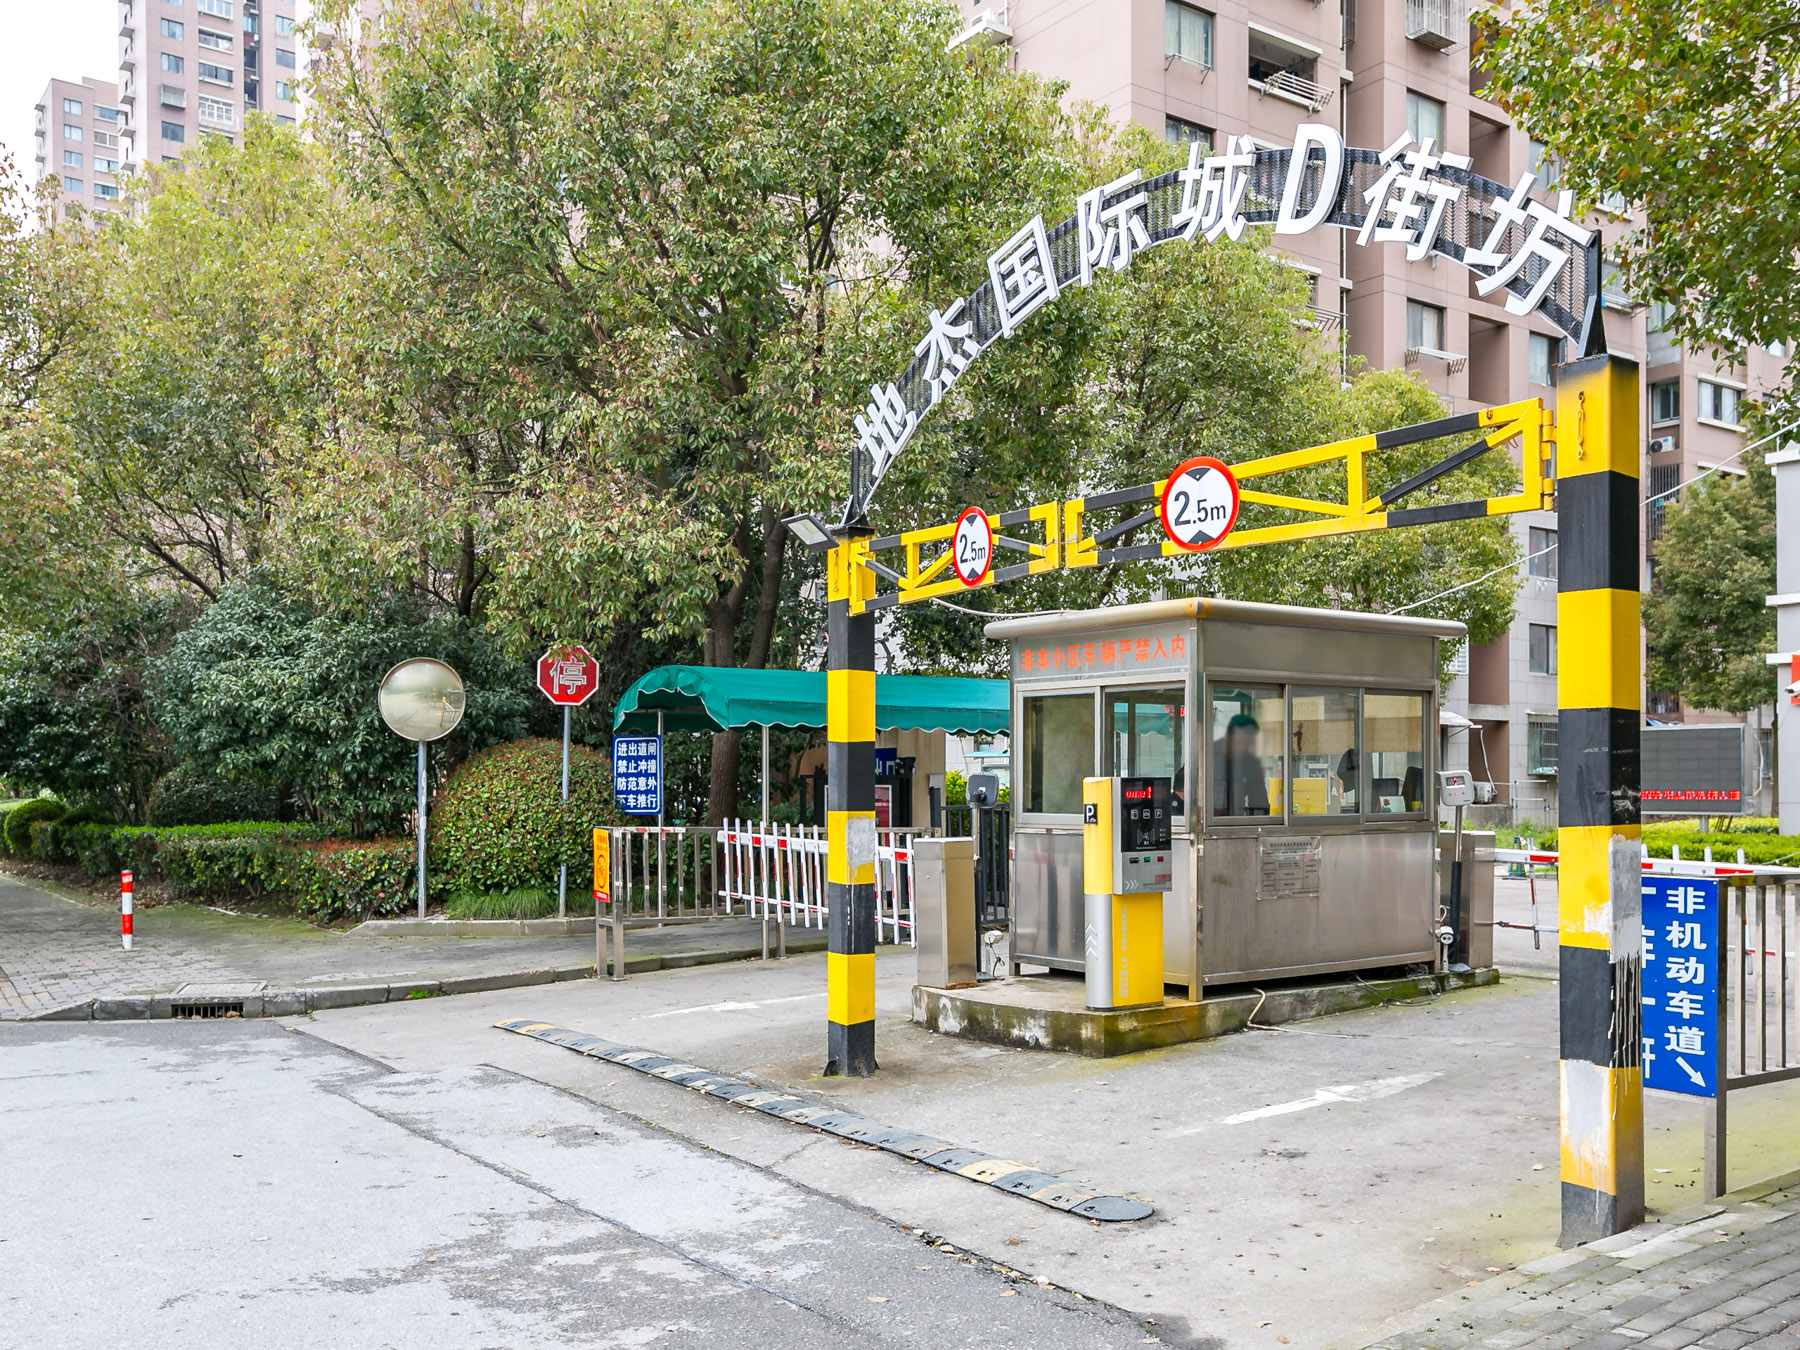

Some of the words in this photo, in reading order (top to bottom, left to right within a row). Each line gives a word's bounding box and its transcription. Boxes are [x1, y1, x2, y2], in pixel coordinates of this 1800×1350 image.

[851, 122, 1596, 477] 地杰国际城D街坊
[1173, 490, 1227, 527] 2.5m
[959, 533, 987, 564] 2.5m
[1020, 633, 1186, 672] 非本小区车辆严禁入内
[550, 655, 587, 694] 停
[617, 759, 657, 773] 禁止冲撞
[617, 776, 657, 791] 防范意外
[1664, 886, 1708, 1056] 非机动车道
